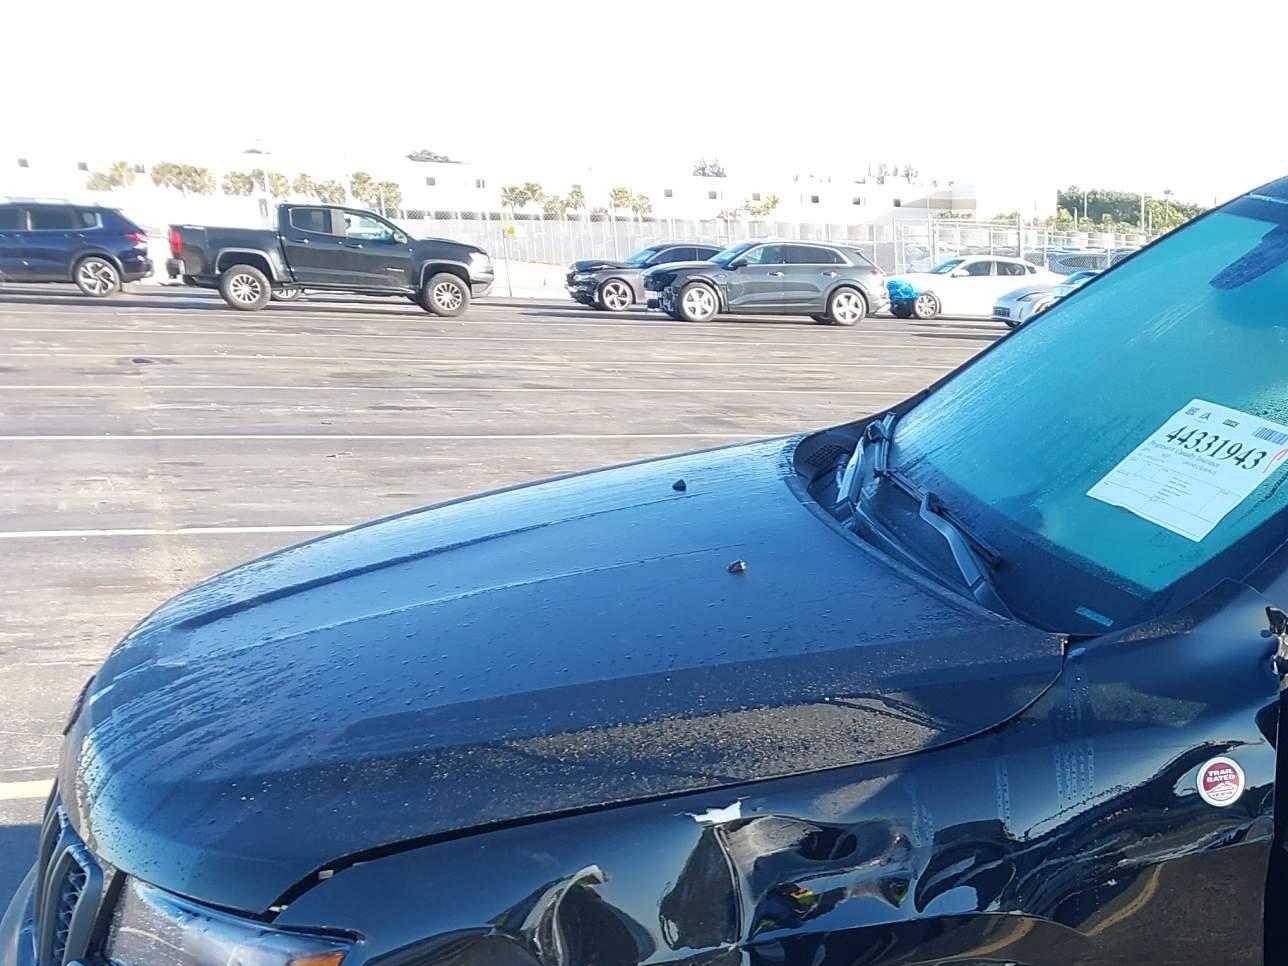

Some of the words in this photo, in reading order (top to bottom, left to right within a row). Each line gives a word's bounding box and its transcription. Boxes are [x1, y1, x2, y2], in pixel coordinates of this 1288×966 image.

[1165, 424, 1267, 470] 44331943
[1207, 768, 1235, 777] TRAIL
[1206, 774, 1236, 783] RATED
